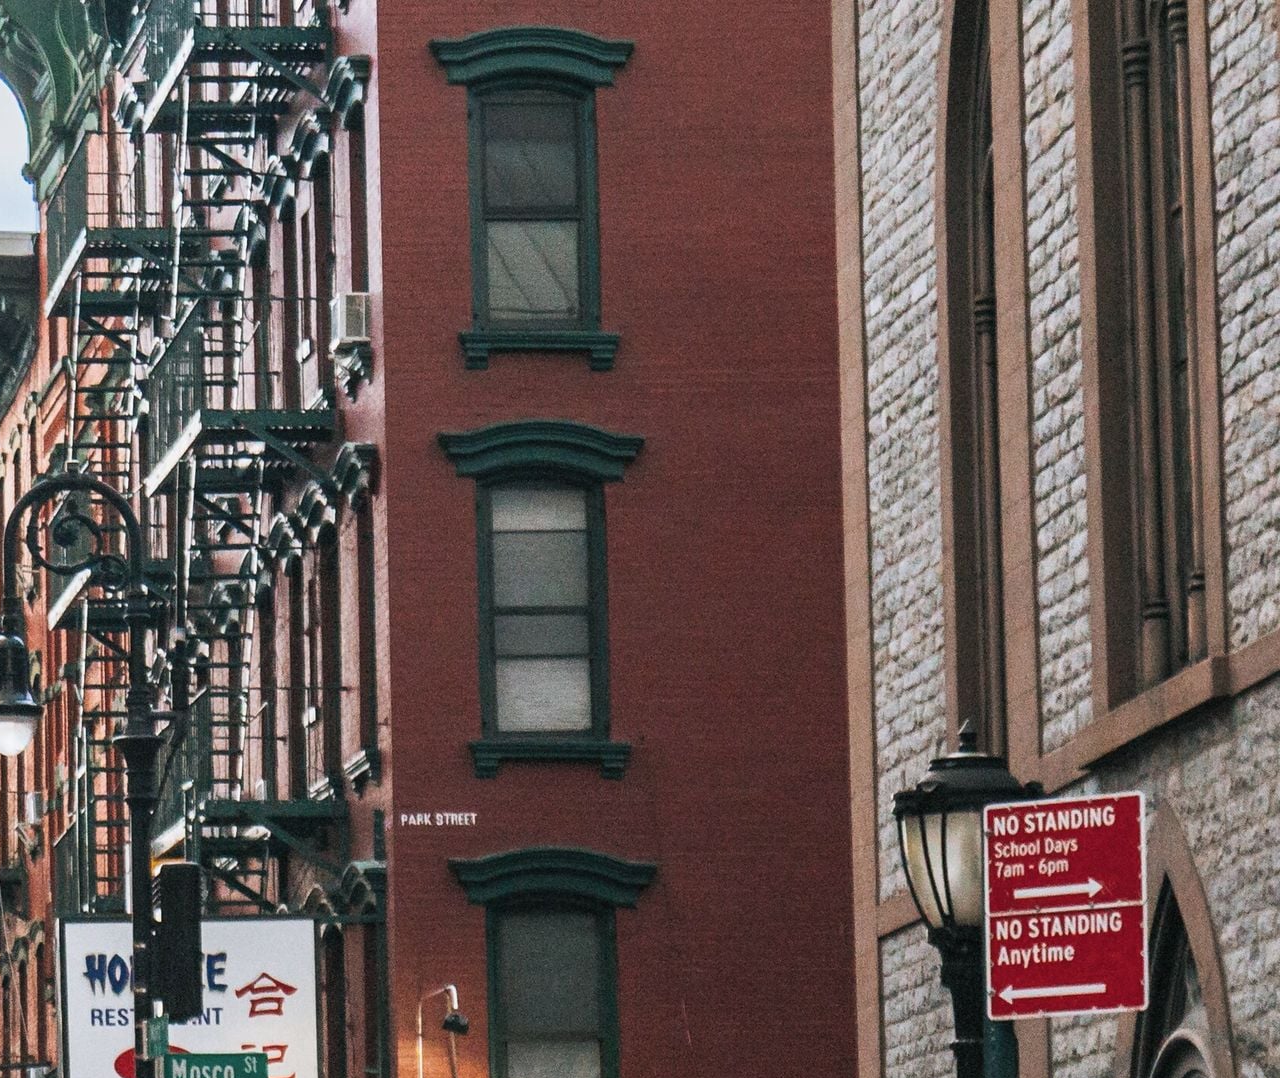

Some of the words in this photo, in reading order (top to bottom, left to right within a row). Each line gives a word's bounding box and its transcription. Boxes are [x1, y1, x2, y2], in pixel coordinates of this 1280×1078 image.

[401, 812, 431, 826] PARK
[435, 812, 478, 826] STREET
[993, 815, 1019, 836] NO
[1025, 806, 1115, 832] STANDING
[994, 839, 1040, 858] School
[1045, 837, 1078, 856] Days
[995, 861, 1024, 878] 7am
[1038, 858, 1069, 877] 6pm
[996, 920, 1022, 940] NO
[1028, 912, 1122, 937] STANDING
[997, 944, 1075, 968] Anytime
[244, 1056, 258, 1073] St
